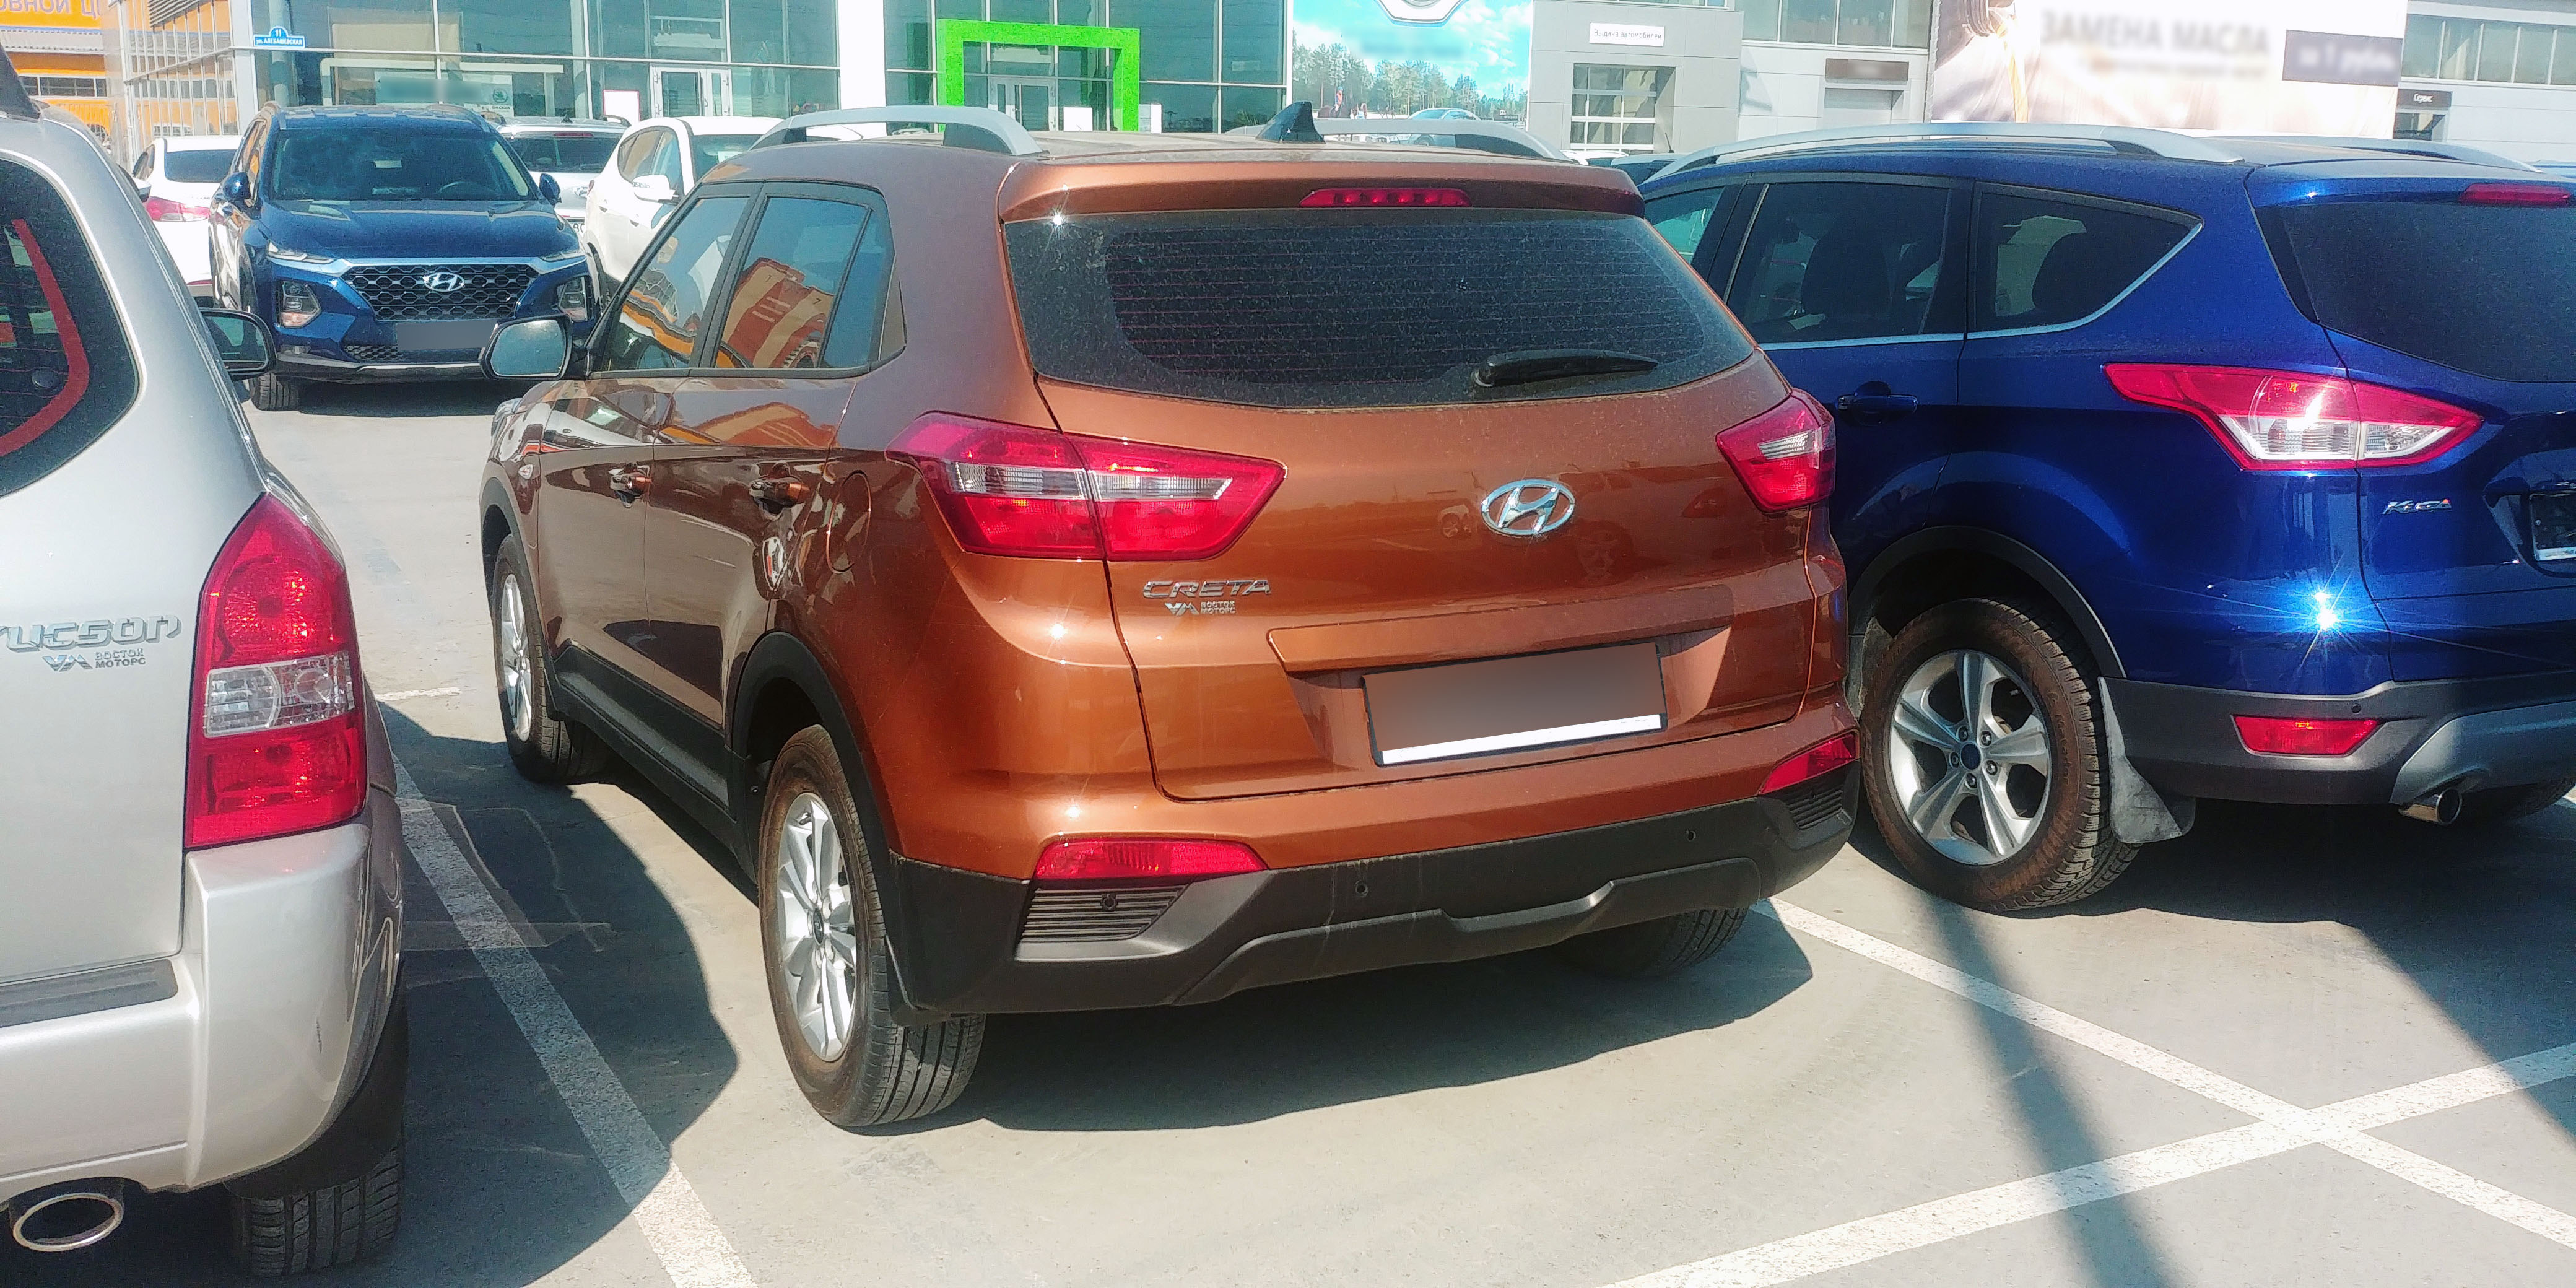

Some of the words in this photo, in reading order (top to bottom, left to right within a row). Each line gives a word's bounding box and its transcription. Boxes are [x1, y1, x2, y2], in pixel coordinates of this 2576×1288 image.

[275, 28, 282, 37] 11
[1594, 29, 1619, 37] Выдача
[1143, 579, 1272, 598] CRETA
[1200, 600, 1235, 608] ВОСТОК
[94, 648, 144, 661] ВОСТОК
[95, 658, 146, 669] МОТОРС
